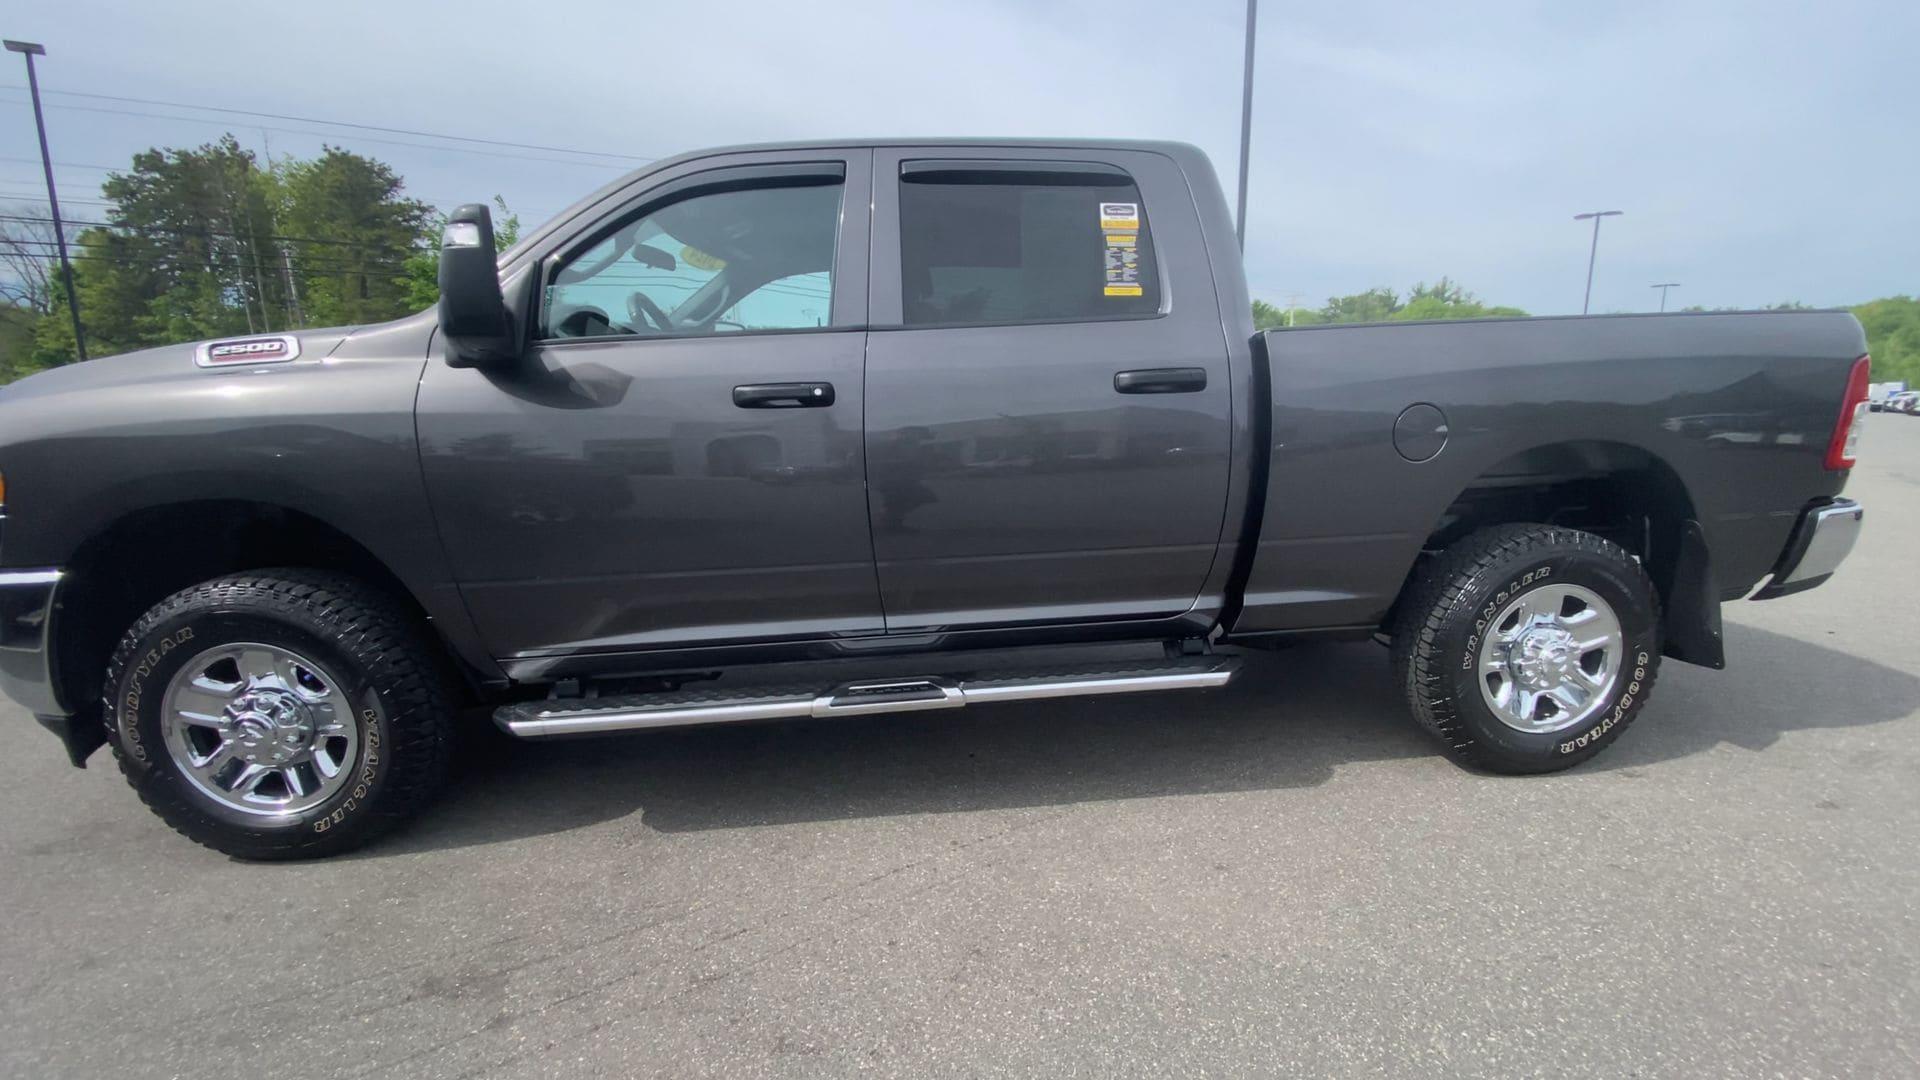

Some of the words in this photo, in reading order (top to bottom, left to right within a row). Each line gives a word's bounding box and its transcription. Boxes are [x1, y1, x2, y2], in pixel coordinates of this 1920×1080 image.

[213, 342, 283, 356] 2500
[1463, 566, 1551, 671] WRANGLER
[124, 627, 194, 762] GOODYEAR
[1560, 652, 1648, 755] GOODYEAR
[314, 708, 381, 833] WRANGLER
